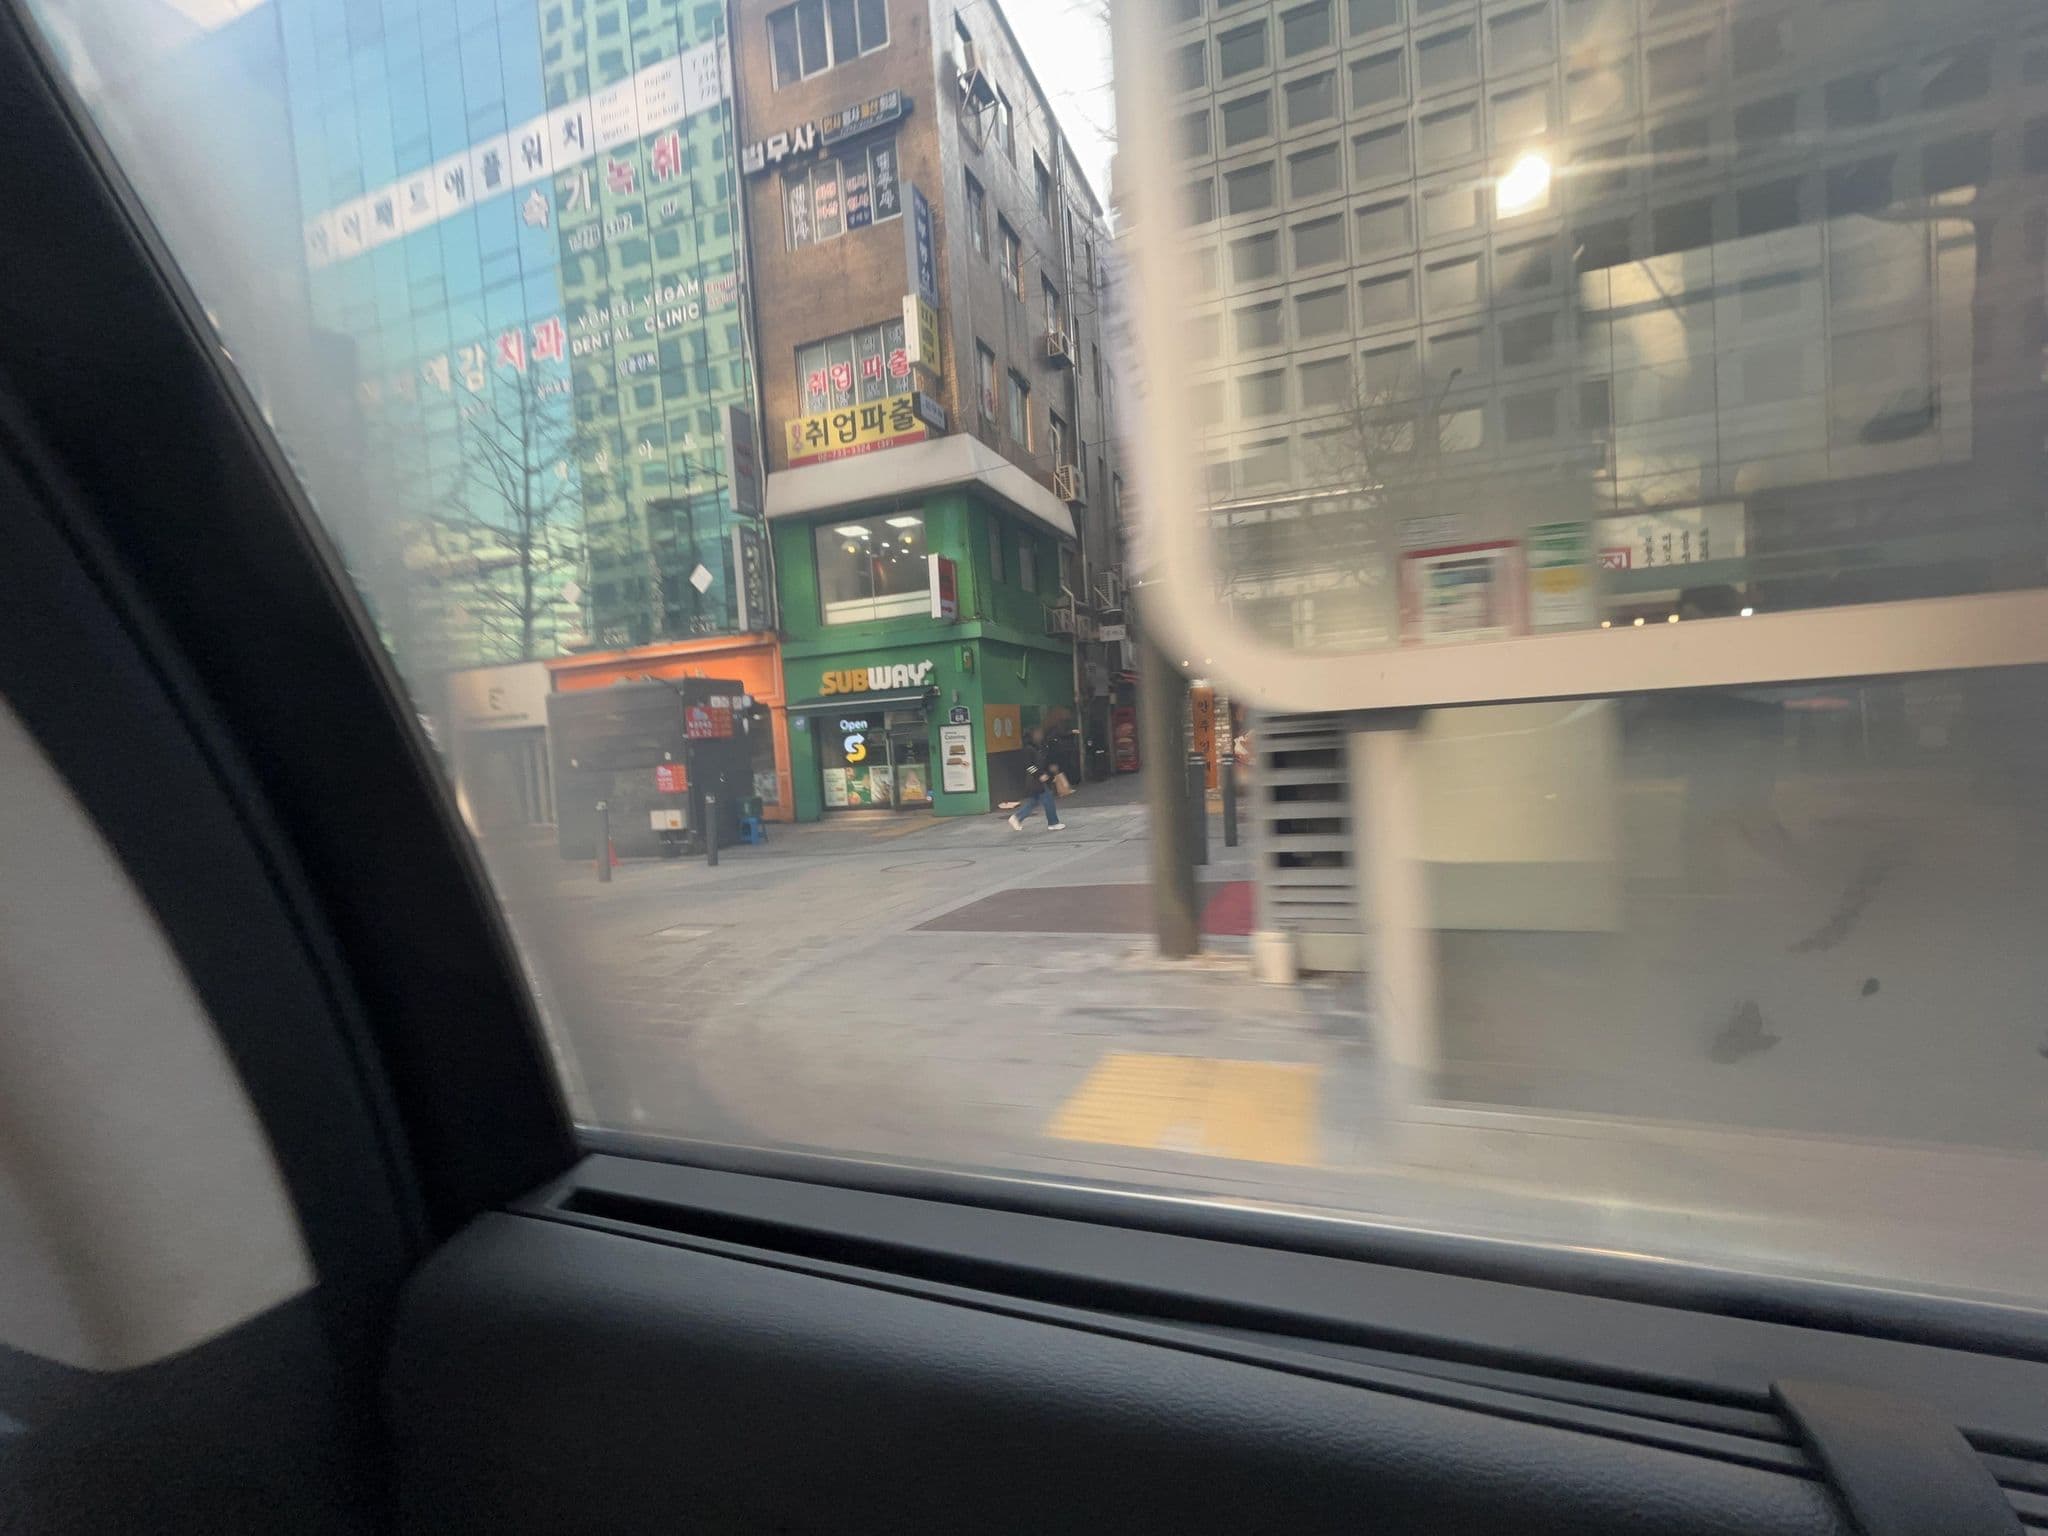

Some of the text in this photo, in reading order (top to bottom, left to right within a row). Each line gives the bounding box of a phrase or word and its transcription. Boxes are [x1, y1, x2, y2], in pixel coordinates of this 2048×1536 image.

[571, 302, 700, 357] DENTAL CLINIC
[805, 397, 916, 448] 취업파출
[819, 659, 934, 697] SUBWAY
[839, 719, 868, 732] Open
